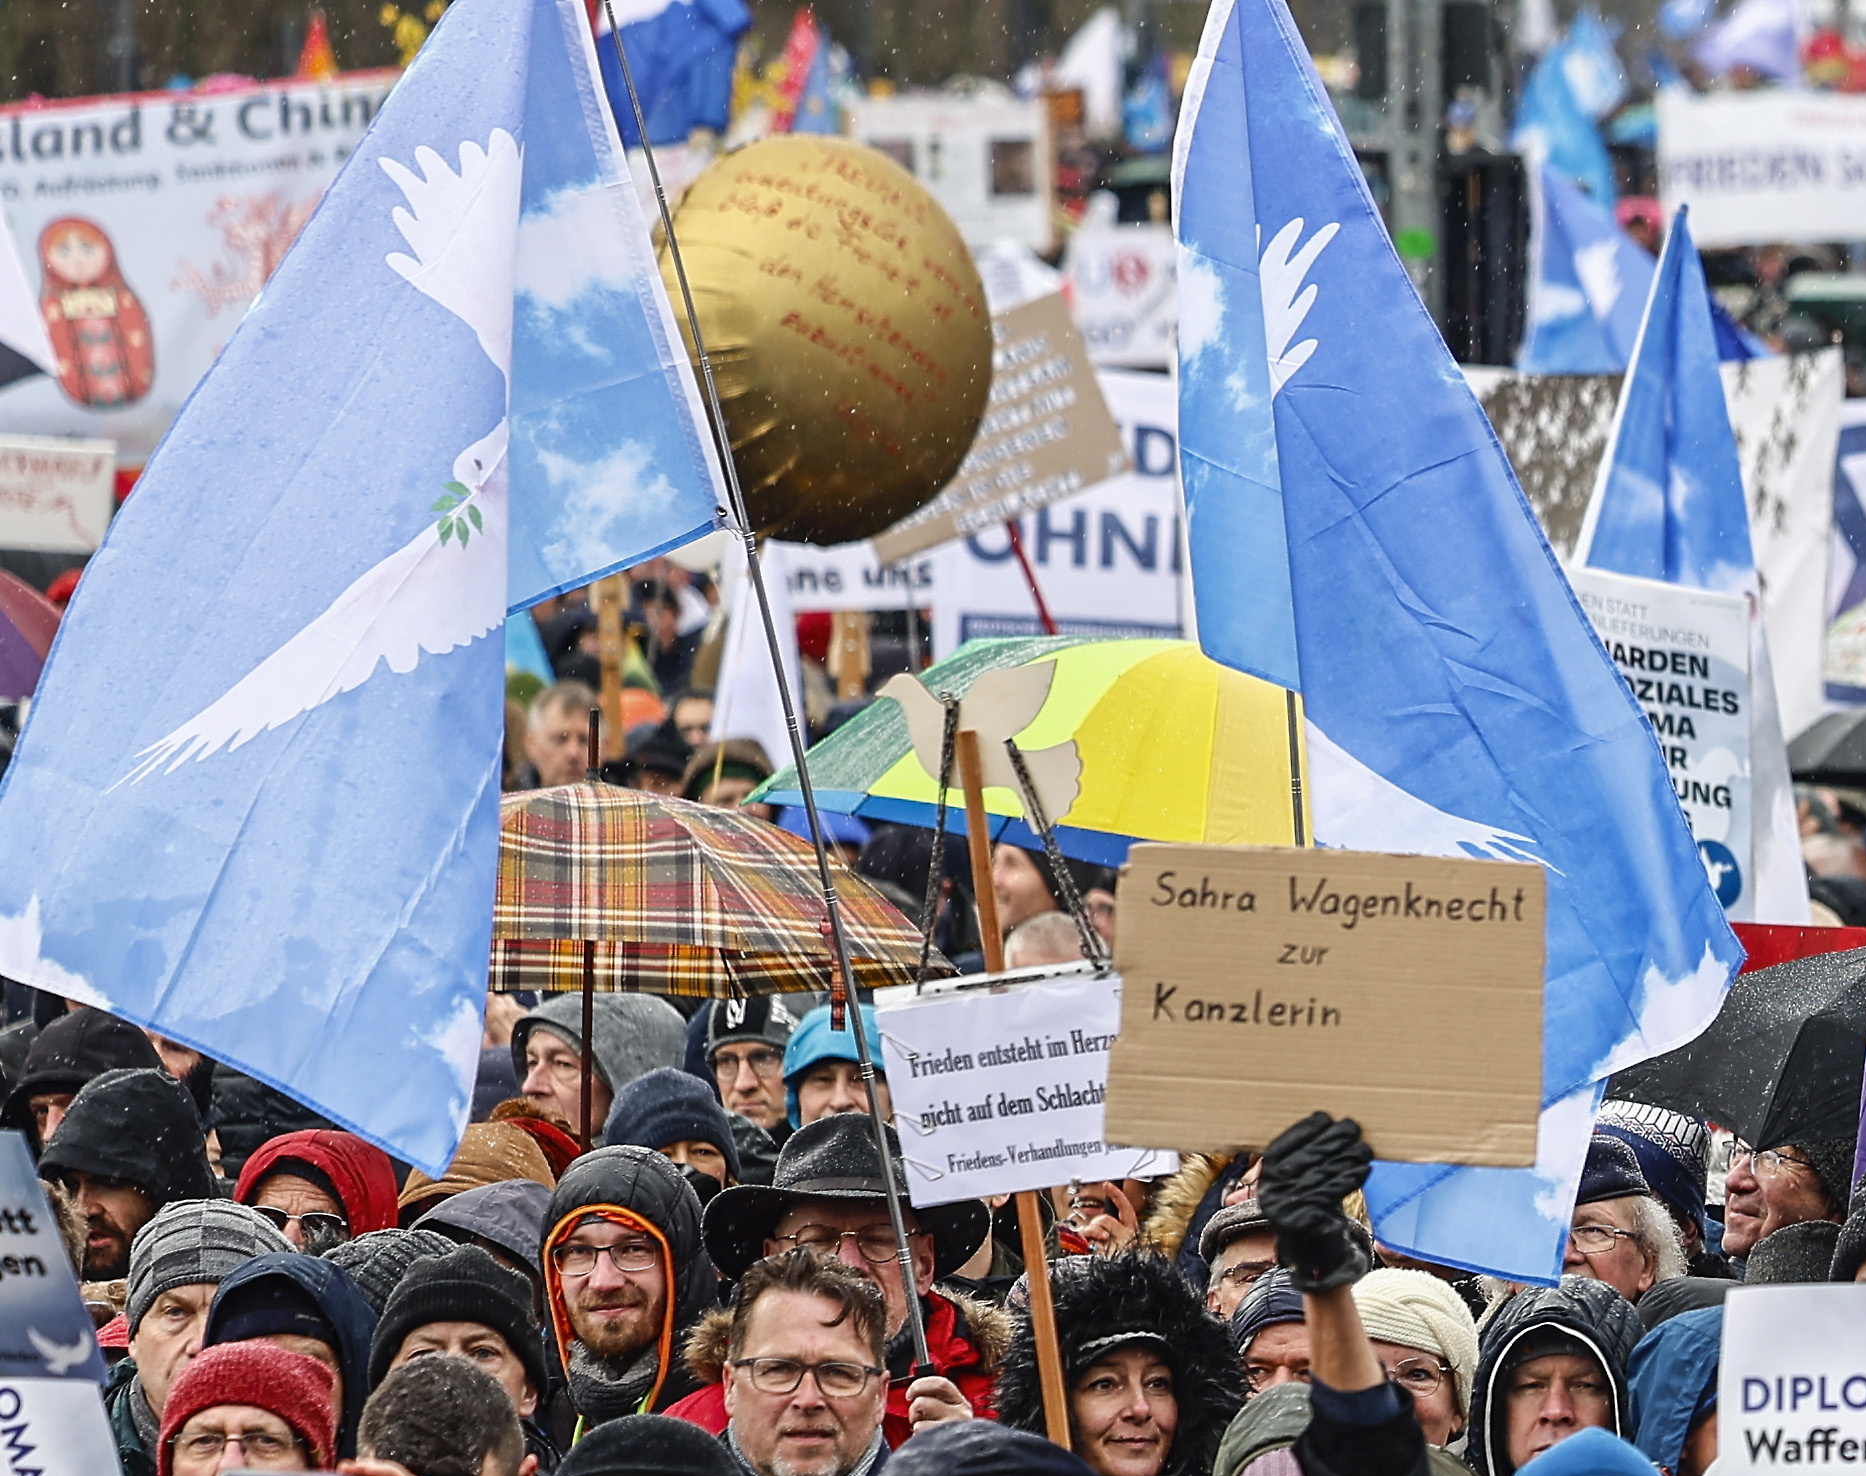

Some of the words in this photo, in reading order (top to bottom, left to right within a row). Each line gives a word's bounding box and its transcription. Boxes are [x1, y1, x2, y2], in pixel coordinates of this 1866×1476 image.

[0, 102, 141, 162] land
[1605, 597, 1647, 620] STATT
[1150, 871, 1257, 914] Sahra
[1288, 876, 1524, 929] Wagenknecht
[1278, 940, 1329, 967] zur
[1151, 983, 1342, 1028] Kanzlerin
[909, 1049, 973, 1081] Frieden
[977, 1040, 1043, 1070] entsteht
[1046, 1037, 1069, 1058] im
[919, 1097, 960, 1132] nicht
[964, 1096, 993, 1124] auf
[997, 1092, 1033, 1120] dem
[946, 1135, 1101, 1175] Friedens-Verhandlungen
